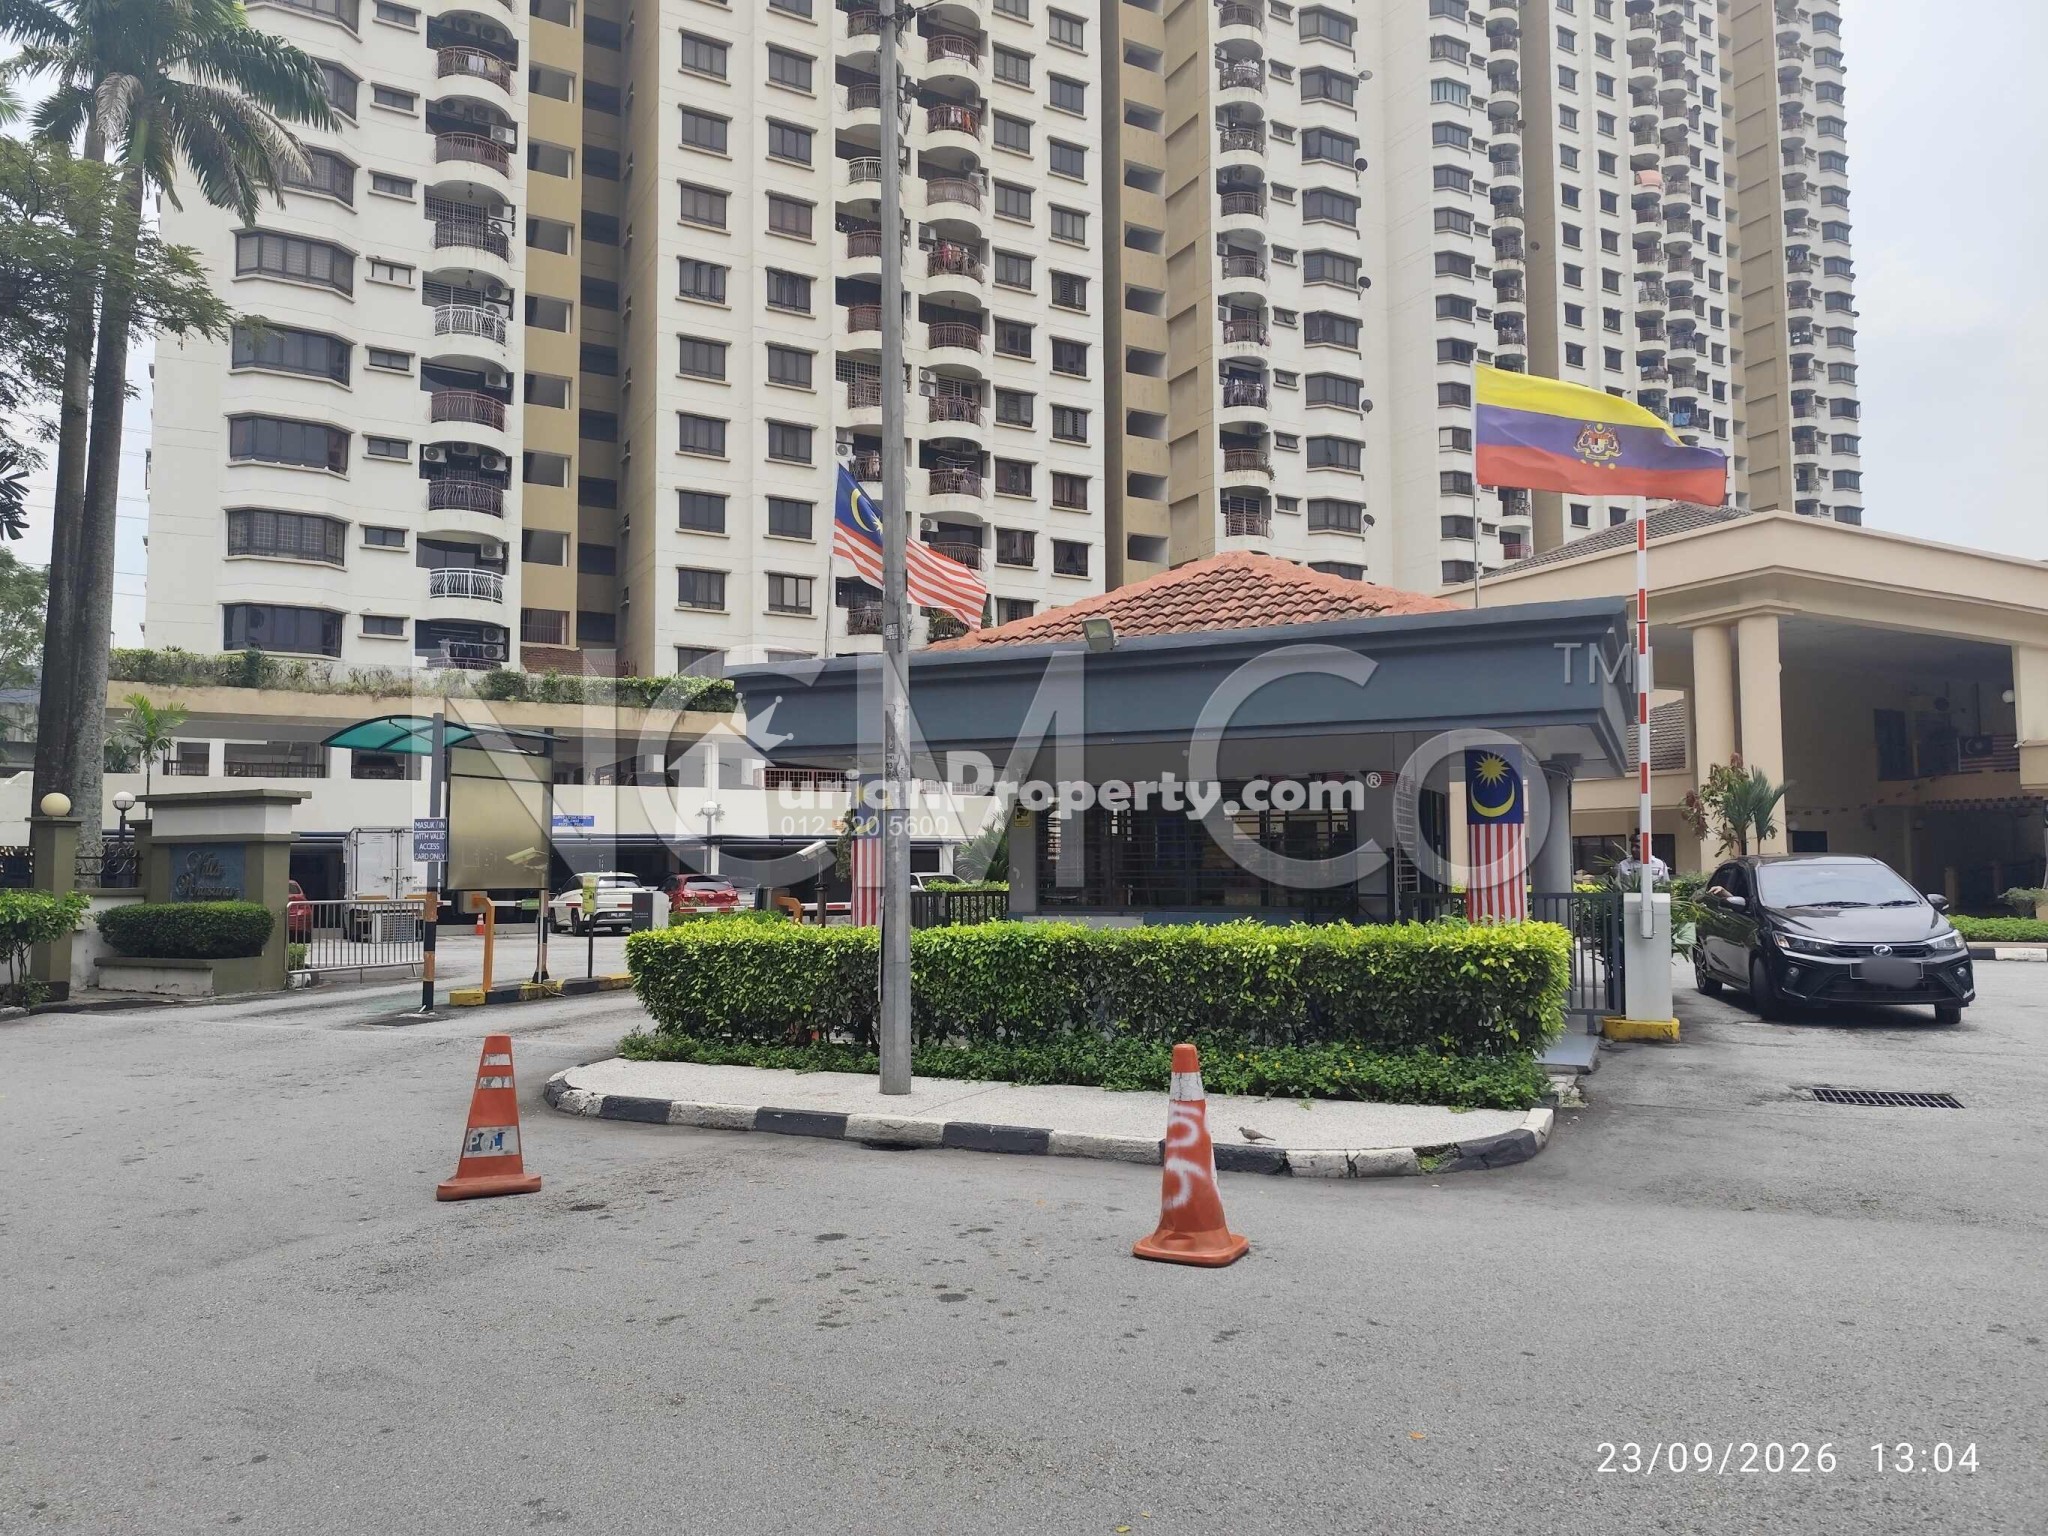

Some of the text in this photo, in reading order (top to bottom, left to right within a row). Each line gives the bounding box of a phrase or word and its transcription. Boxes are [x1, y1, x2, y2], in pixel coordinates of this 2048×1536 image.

[415, 821, 435, 829] MASUK
[415, 832, 446, 841] WITH VALID
[419, 842, 440, 850] ACCESS
[415, 852, 446, 860] CARD ONLY
